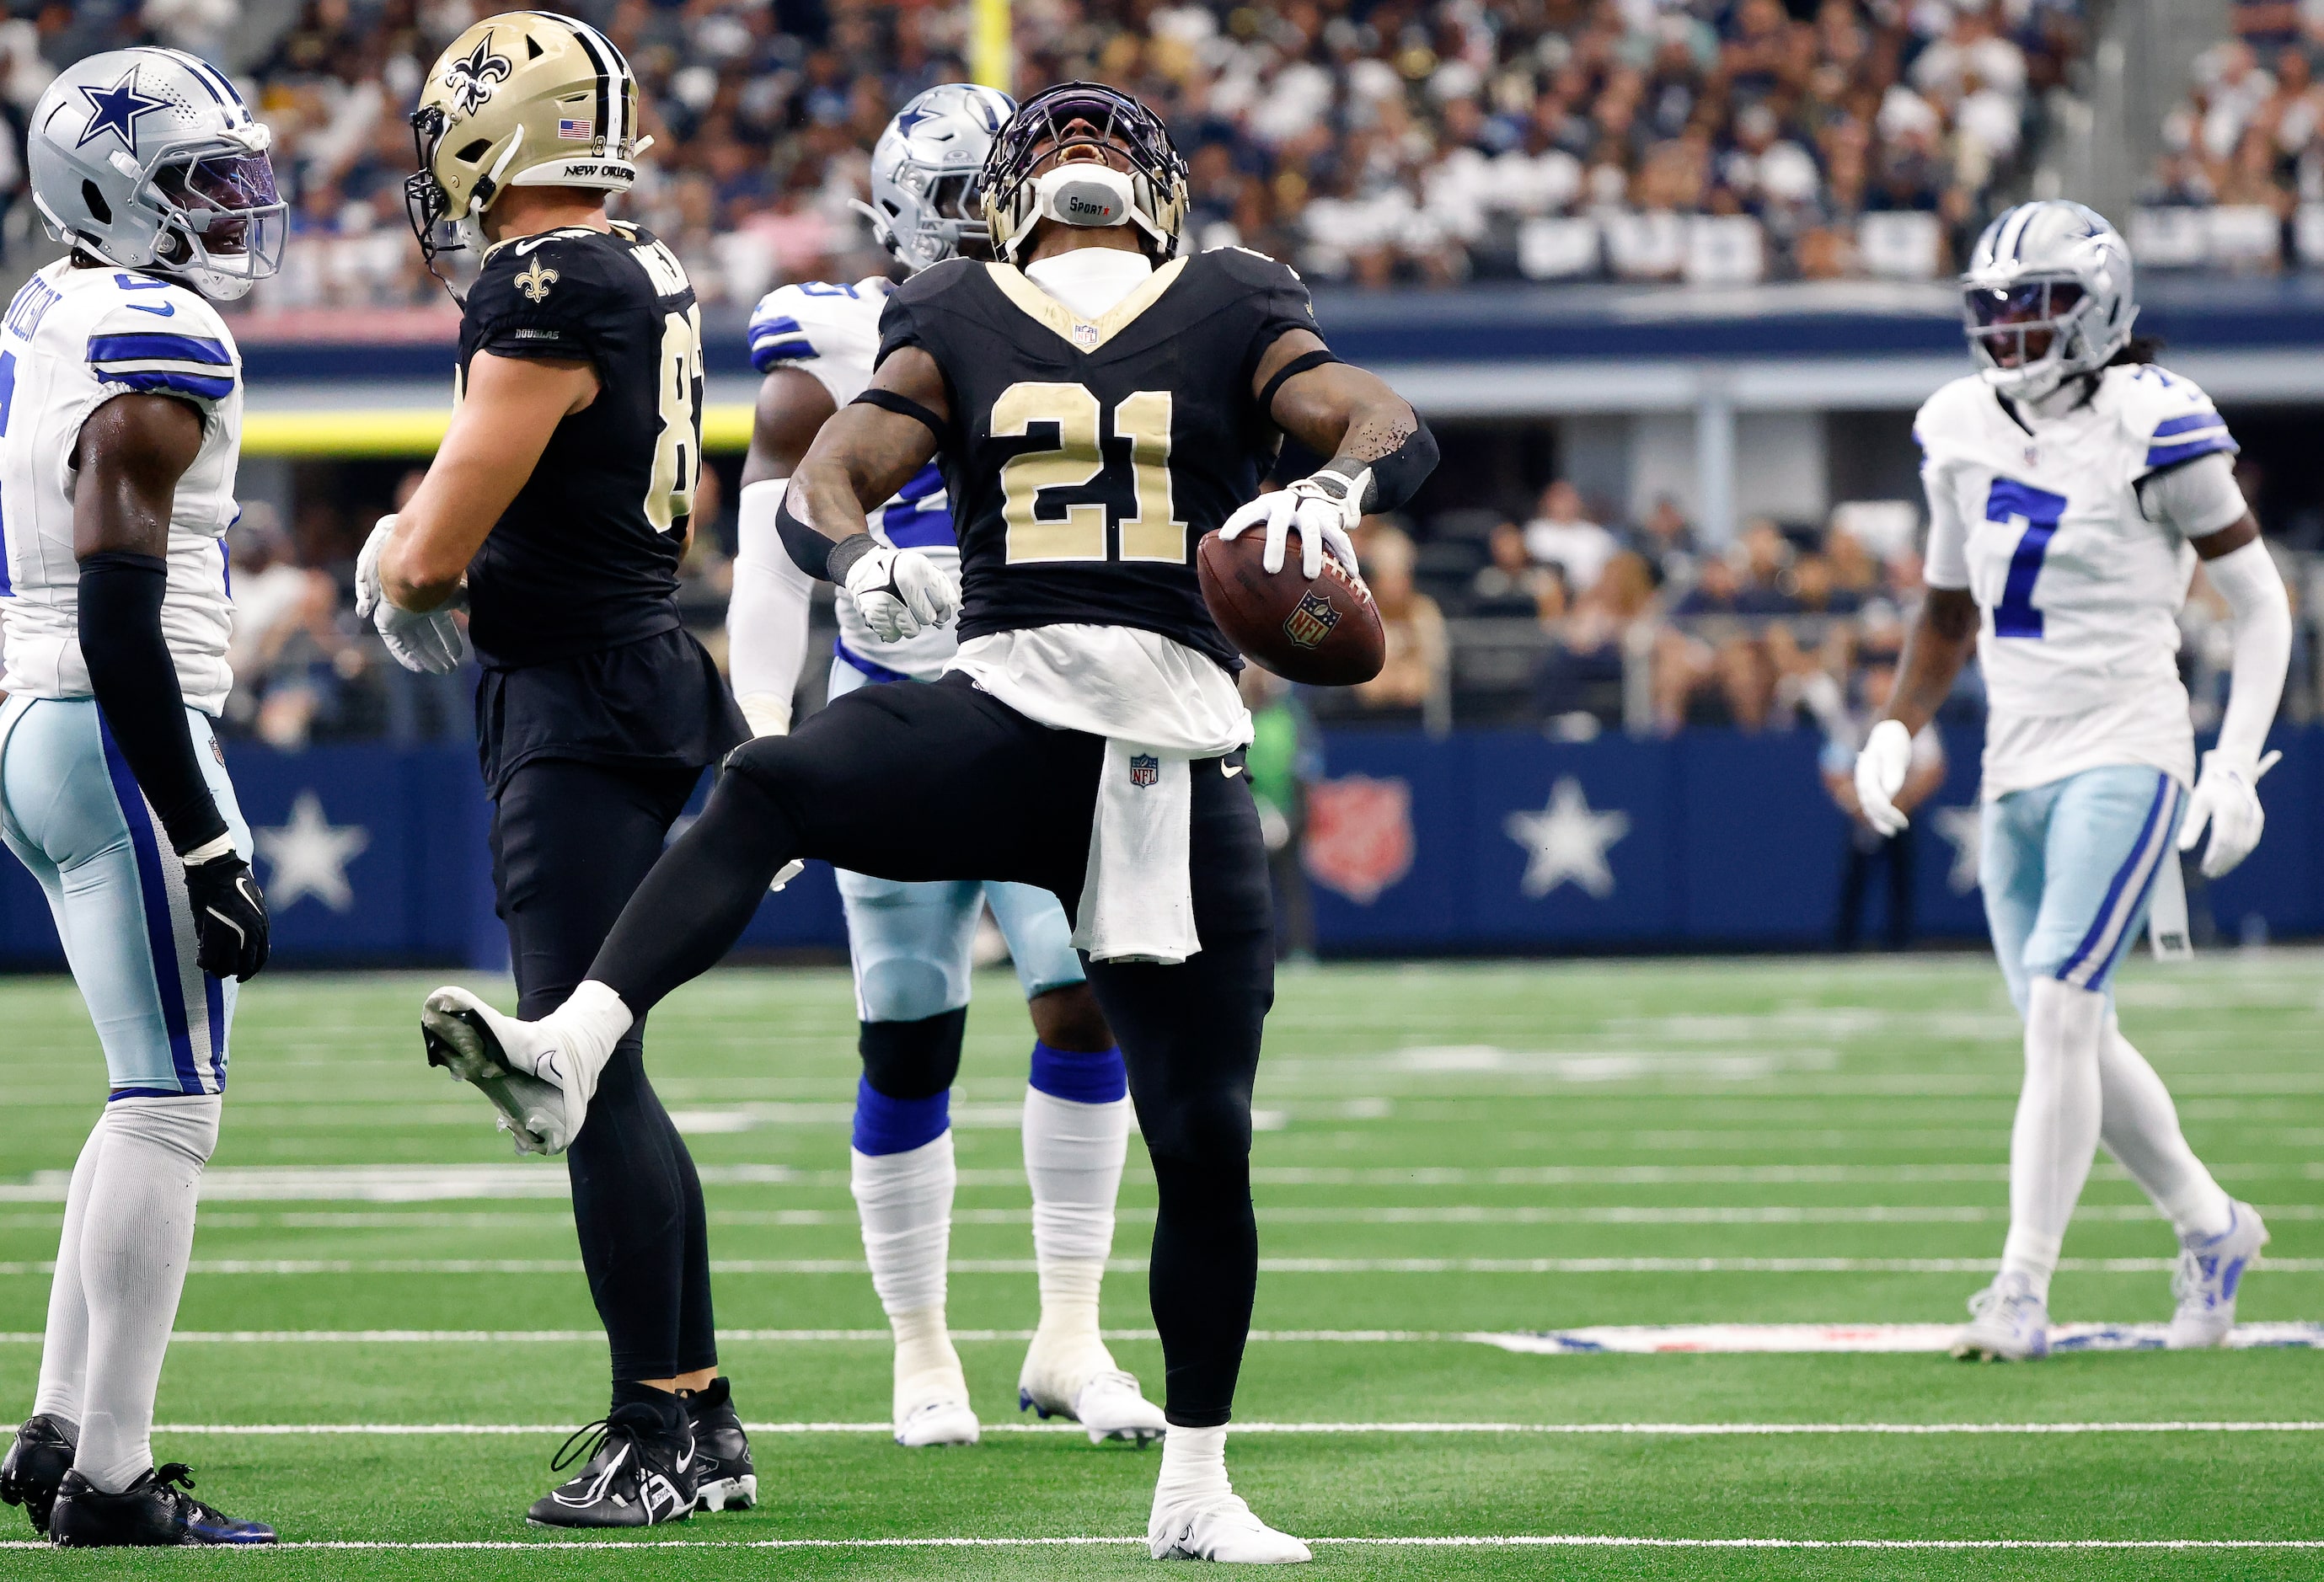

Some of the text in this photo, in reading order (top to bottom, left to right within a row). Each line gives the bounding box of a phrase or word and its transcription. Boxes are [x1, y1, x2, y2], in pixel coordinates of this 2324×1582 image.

[563, 165, 598, 177] NEW
[1069, 196, 1103, 216] SPORT
[990, 382, 1188, 565] 21
[1985, 477, 2069, 639] 7
[1288, 609, 1325, 647] NFL
[1132, 767, 1155, 785] NFL
